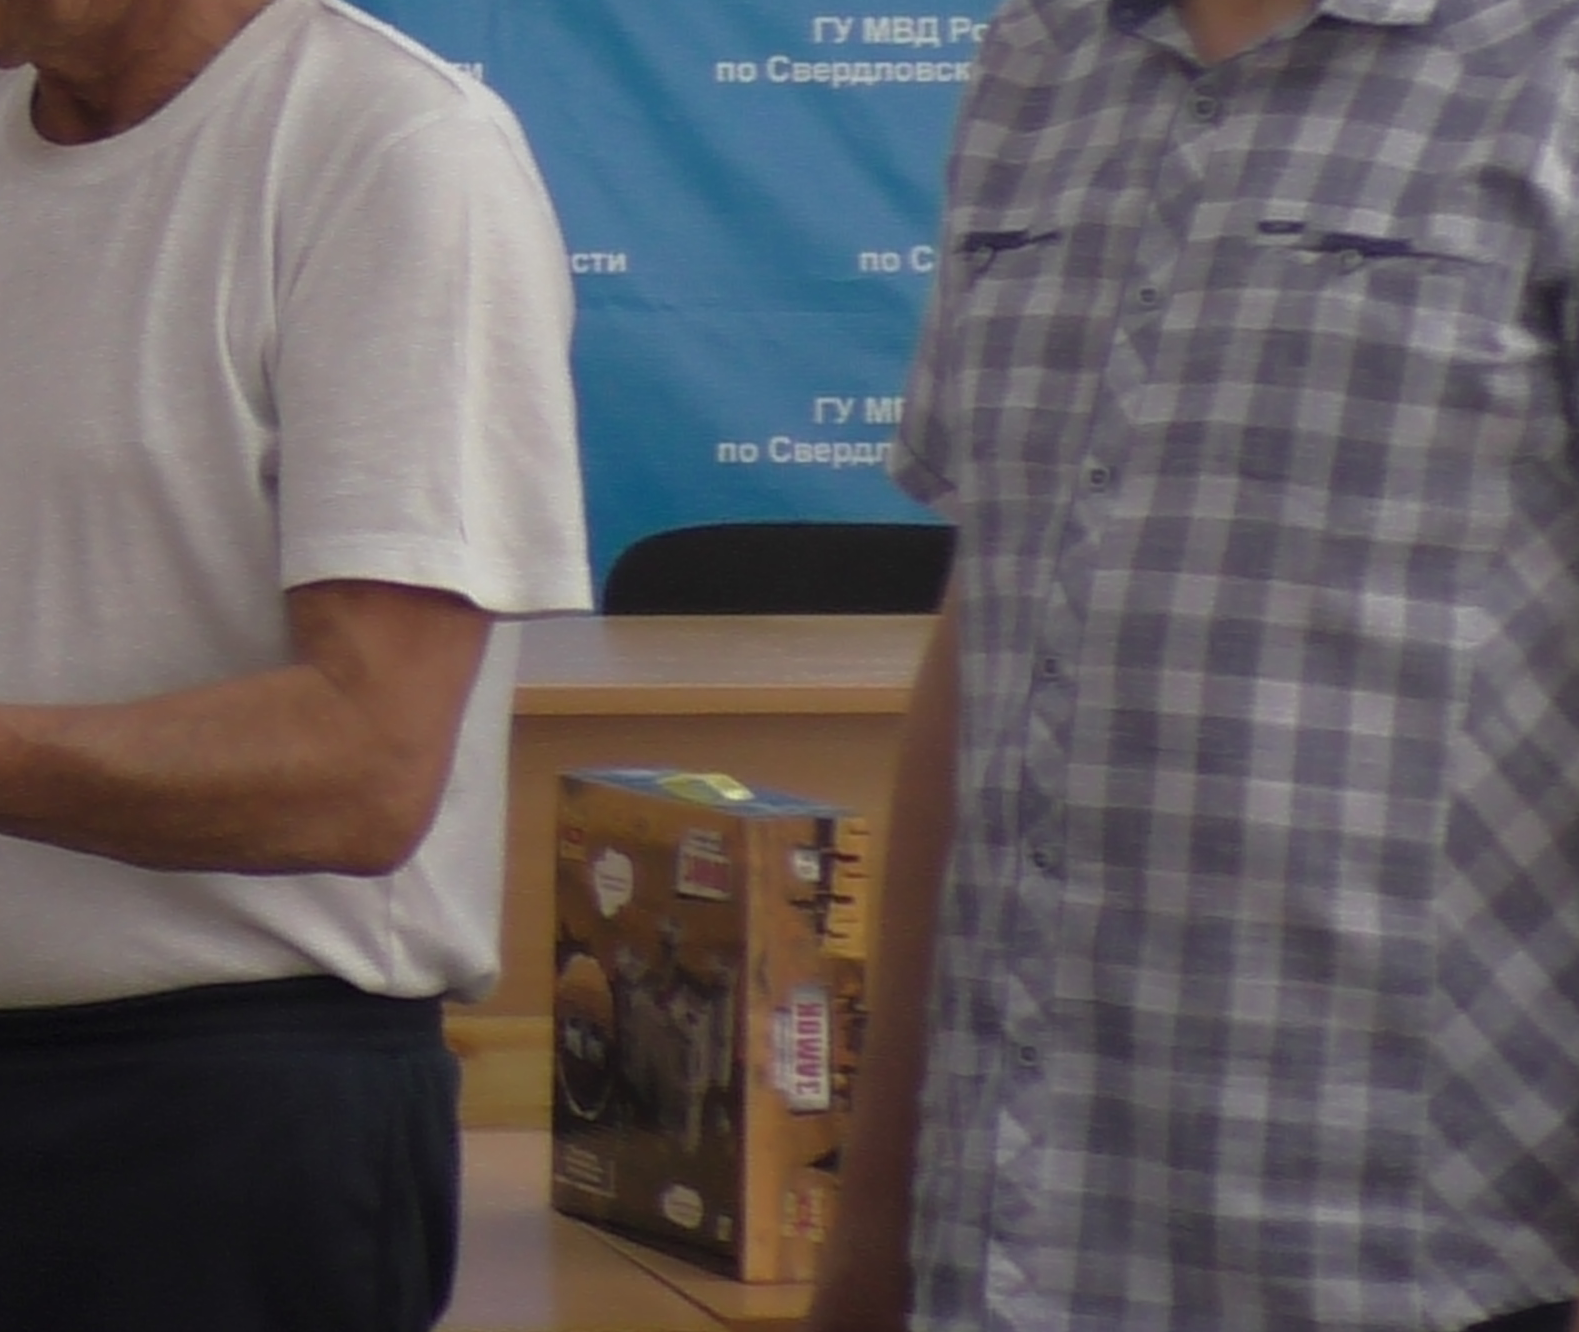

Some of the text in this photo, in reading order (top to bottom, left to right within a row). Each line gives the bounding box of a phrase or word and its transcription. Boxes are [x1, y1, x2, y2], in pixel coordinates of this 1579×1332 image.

[813, 16, 854, 44] ГУ
[862, 16, 942, 48] МВД
[715, 61, 758, 83] по
[858, 251, 902, 273] по
[813, 396, 855, 424] ГУ
[716, 442, 760, 463] по
